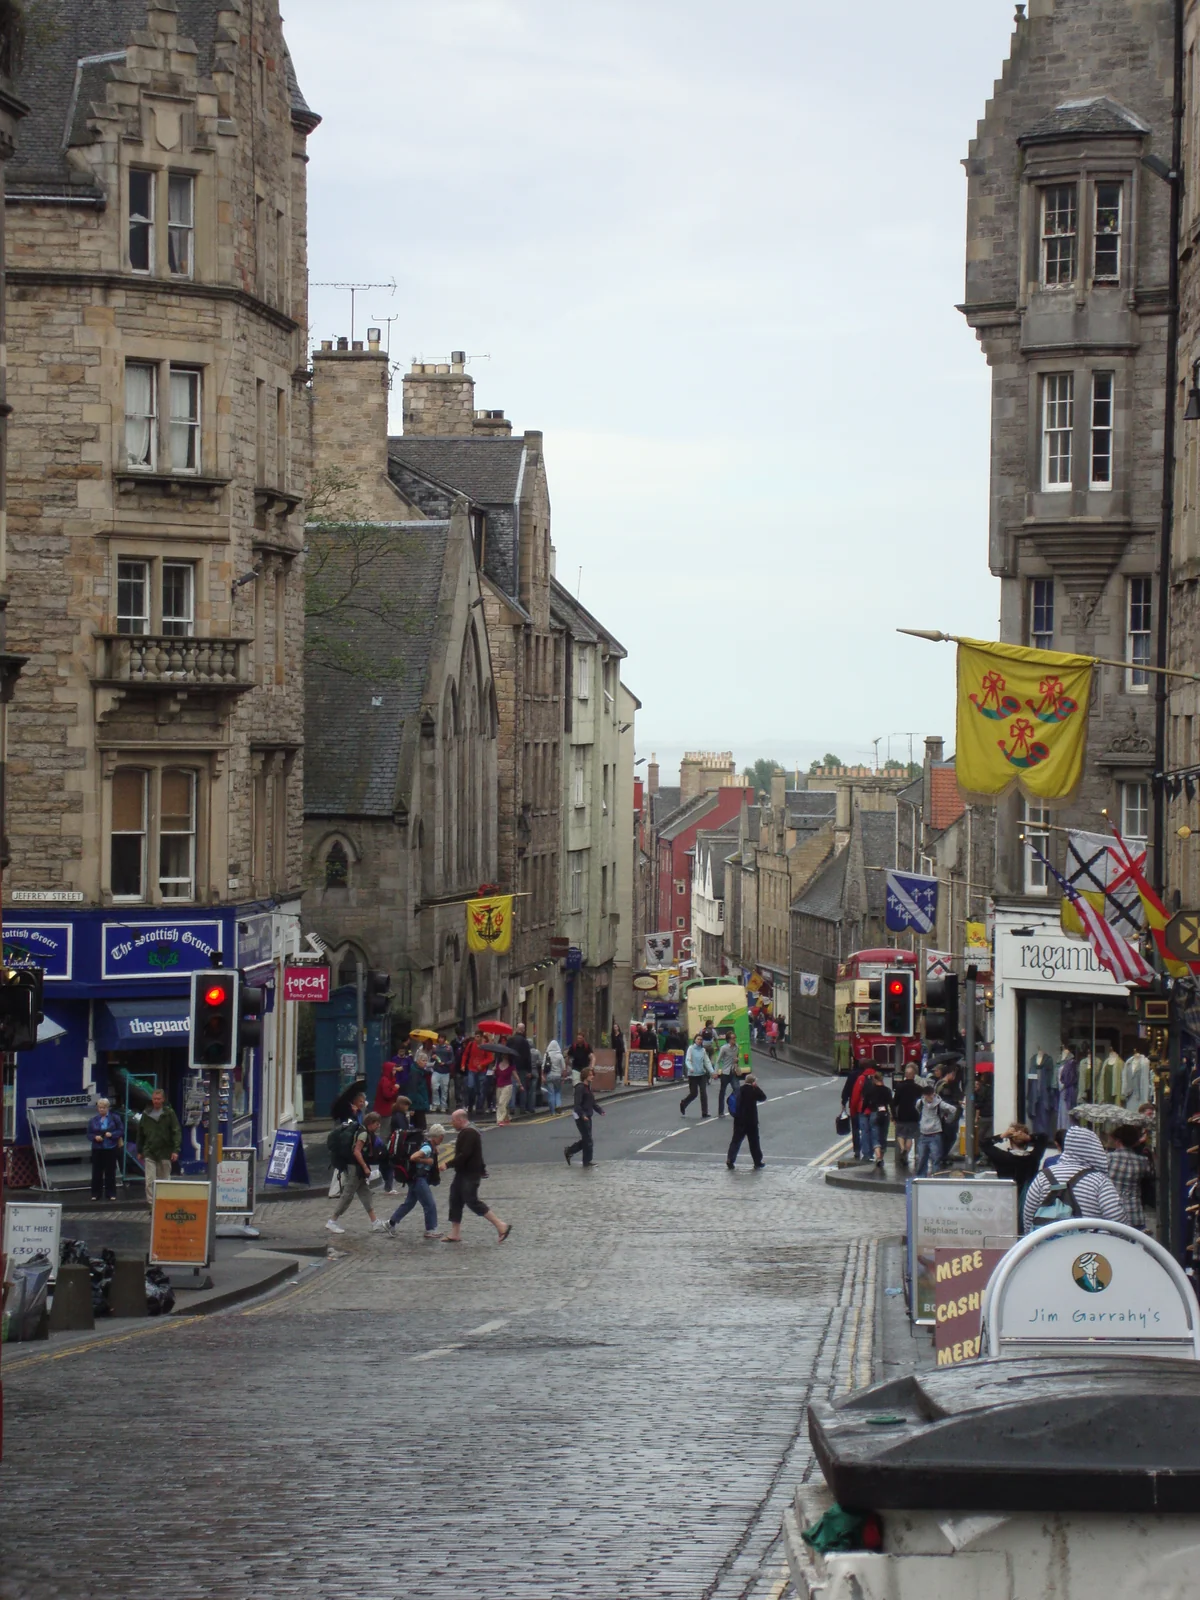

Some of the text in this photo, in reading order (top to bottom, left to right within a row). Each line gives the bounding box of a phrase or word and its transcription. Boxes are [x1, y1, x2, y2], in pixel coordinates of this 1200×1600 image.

[2, 929, 58, 949] cottish Grocer
[111, 928, 214, 960] The Scottish Grocer
[1020, 944, 1111, 979] ragamu
[698, 1003, 736, 1013] Edinburgh
[130, 1016, 192, 1037] theguard
[36, 1095, 92, 1106] NEWSPAPERS
[219, 1165, 241, 1175] LIVE
[12, 1224, 55, 1233] KILT HIRE
[923, 1226, 983, 1236] Highland Tours
[936, 1250, 984, 1283] MERE
[1028, 1307, 1162, 1329] Jim Garrahy's
